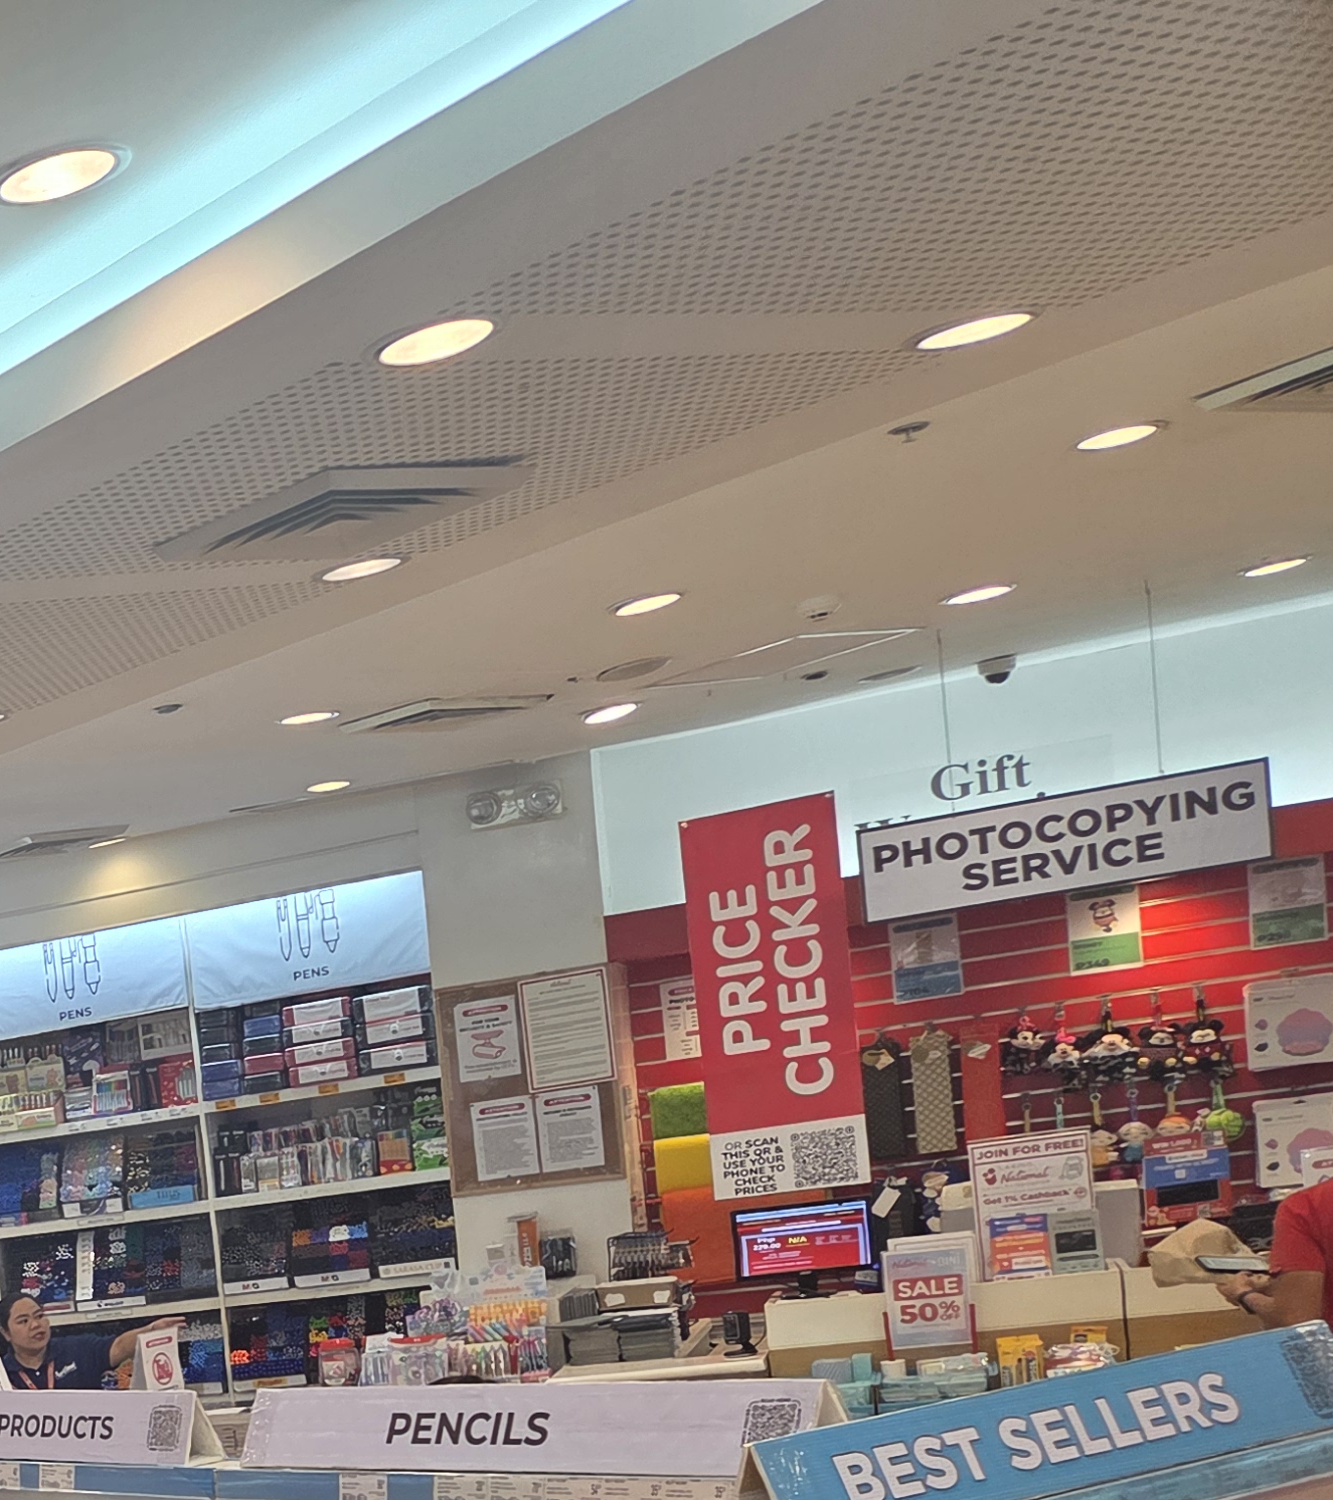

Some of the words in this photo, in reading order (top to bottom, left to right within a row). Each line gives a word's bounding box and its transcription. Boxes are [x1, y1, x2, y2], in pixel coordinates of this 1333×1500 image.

[931, 753, 1033, 803] Gift
[872, 781, 1256, 874] PHOTOCOPYING
[962, 831, 1166, 892] SERVICE
[764, 823, 835, 1096] CHECKER
[293, 966, 329, 980] PENS
[710, 884, 771, 1056] PRICE
[60, 1007, 92, 1020] PENS
[745, 1137, 779, 1148] SCAN
[977, 1147, 1009, 1161] JOIN
[1012, 1144, 1040, 1157] FOR
[1044, 1139, 1083, 1152] FREE!
[722, 1150, 753, 1160] THIS
[723, 1159, 747, 1170] USE
[748, 1154, 784, 1168] YOUR
[723, 1166, 767, 1179] PHONE
[769, 1163, 786, 1174] TO
[734, 1175, 776, 1186] CHECK
[734, 1183, 778, 1196] PRICES
[898, 1277, 960, 1296] SALE
[386, 1411, 550, 1447] PENCILS
[1001, 1373, 1240, 1471] SELLERS
